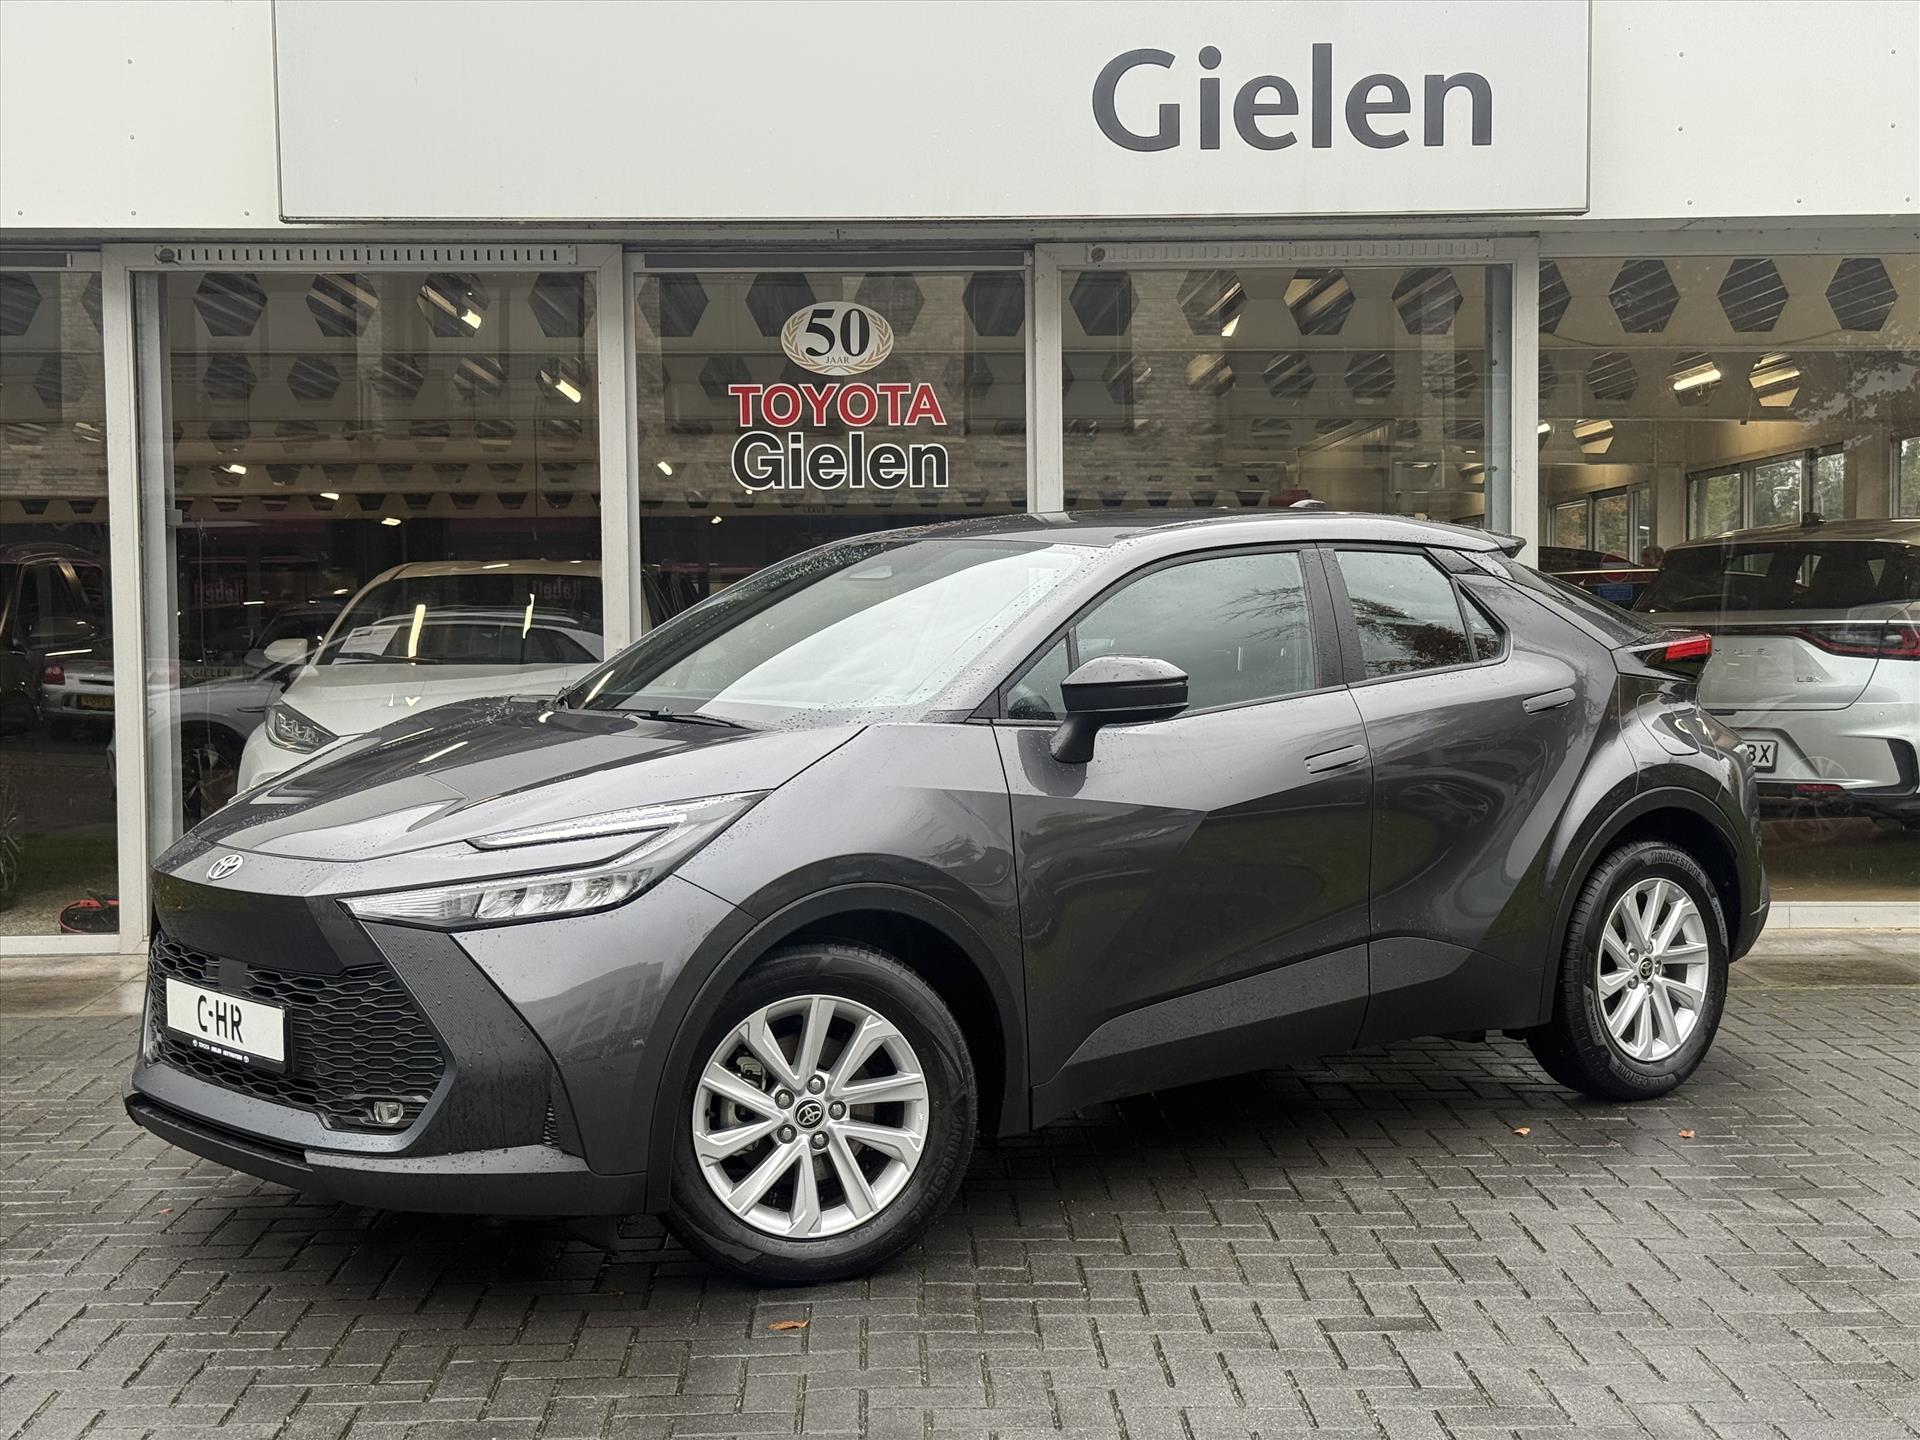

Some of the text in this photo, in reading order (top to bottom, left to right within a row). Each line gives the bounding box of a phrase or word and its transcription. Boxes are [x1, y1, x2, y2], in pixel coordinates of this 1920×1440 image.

[1092, 42, 1493, 152] Gielen
[805, 308, 870, 357] 50
[825, 356, 850, 365] JAAR
[728, 383, 948, 428] TOYOTA
[731, 431, 949, 491] Gielen
[1651, 851, 1704, 879] BRIDGESTONE
[197, 994, 244, 1045] C-HR
